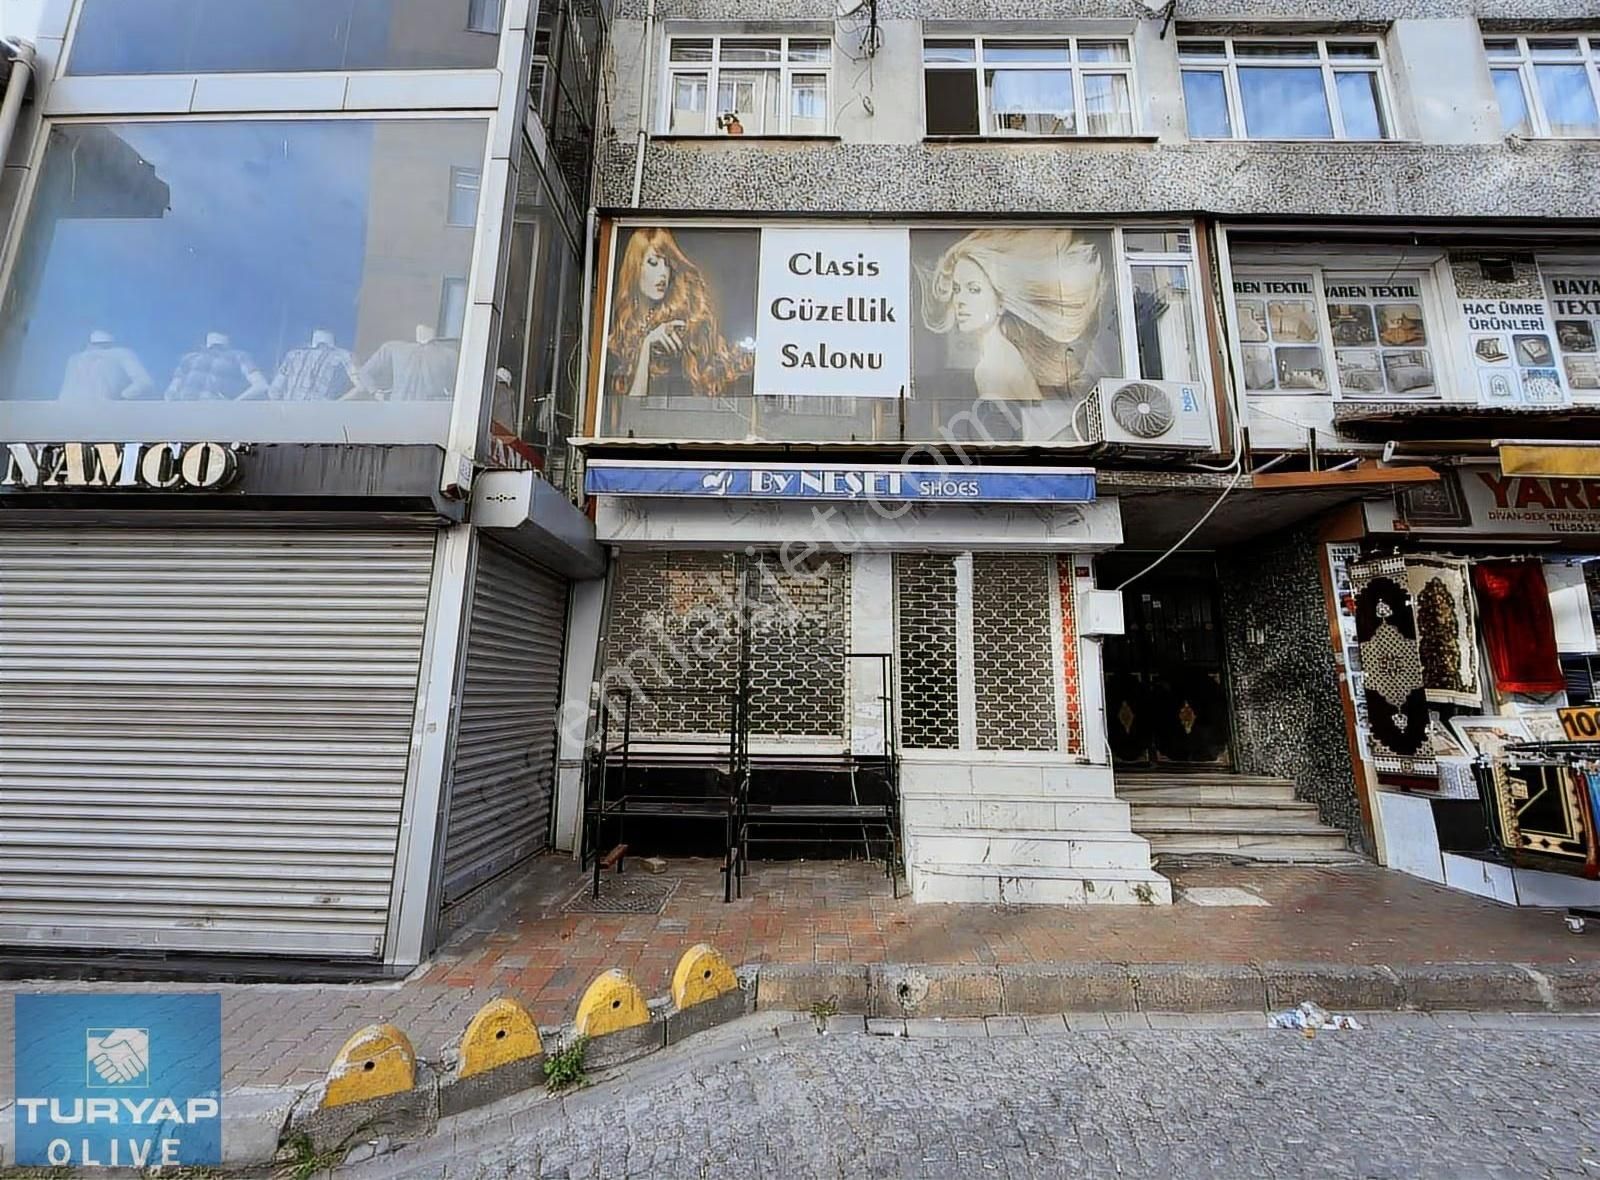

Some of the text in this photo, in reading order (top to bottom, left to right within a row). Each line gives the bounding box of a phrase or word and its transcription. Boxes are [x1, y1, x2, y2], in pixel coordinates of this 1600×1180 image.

[788, 252, 880, 277] Clasis
[771, 297, 896, 322] Güzellik
[1463, 301, 1544, 315] HAC ÜMRE
[1468, 317, 1545, 331] ÜRÜNLERİ
[781, 343, 882, 369] Salonu
[1, 442, 228, 488] NAMCO
[751, 470, 979, 498] By NEŞET SHOES
